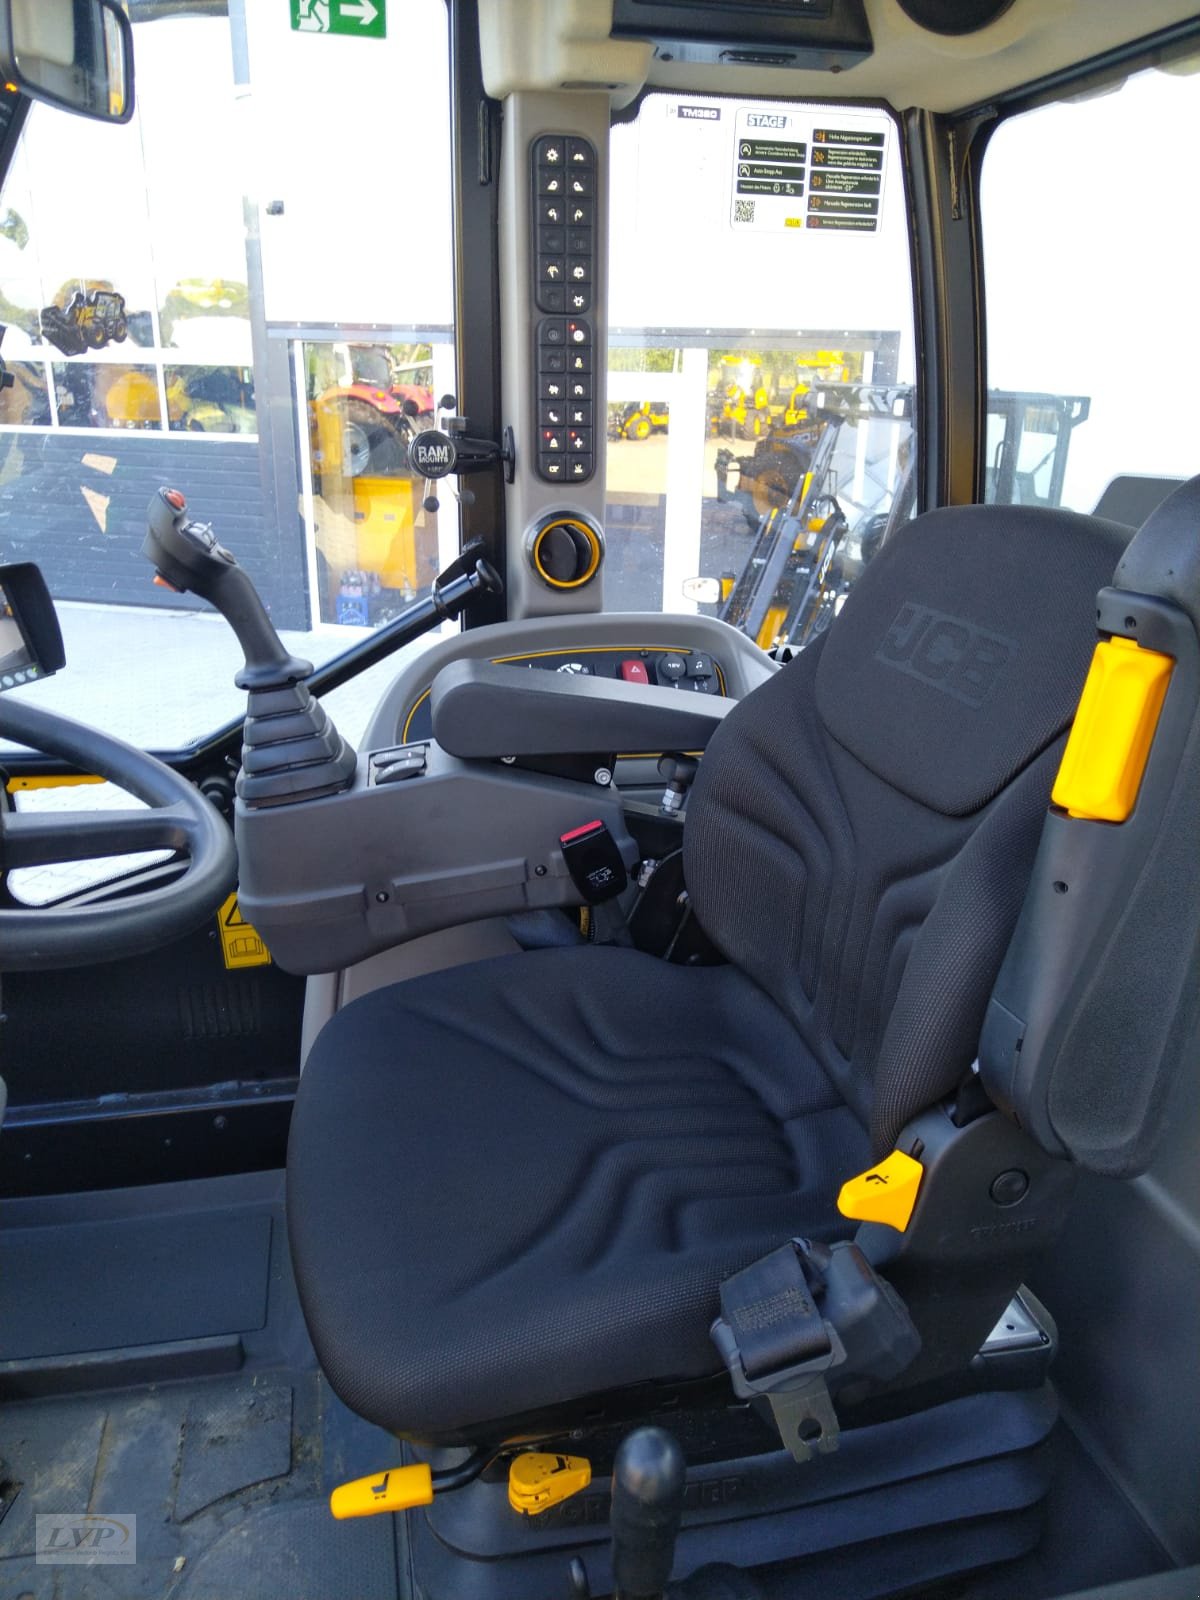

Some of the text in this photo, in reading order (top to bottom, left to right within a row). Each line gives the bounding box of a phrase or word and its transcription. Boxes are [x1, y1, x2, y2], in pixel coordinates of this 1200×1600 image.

[747, 114, 785, 128] STAGE
[418, 445, 448, 457] RAM
[879, 604, 1010, 700] JCB
